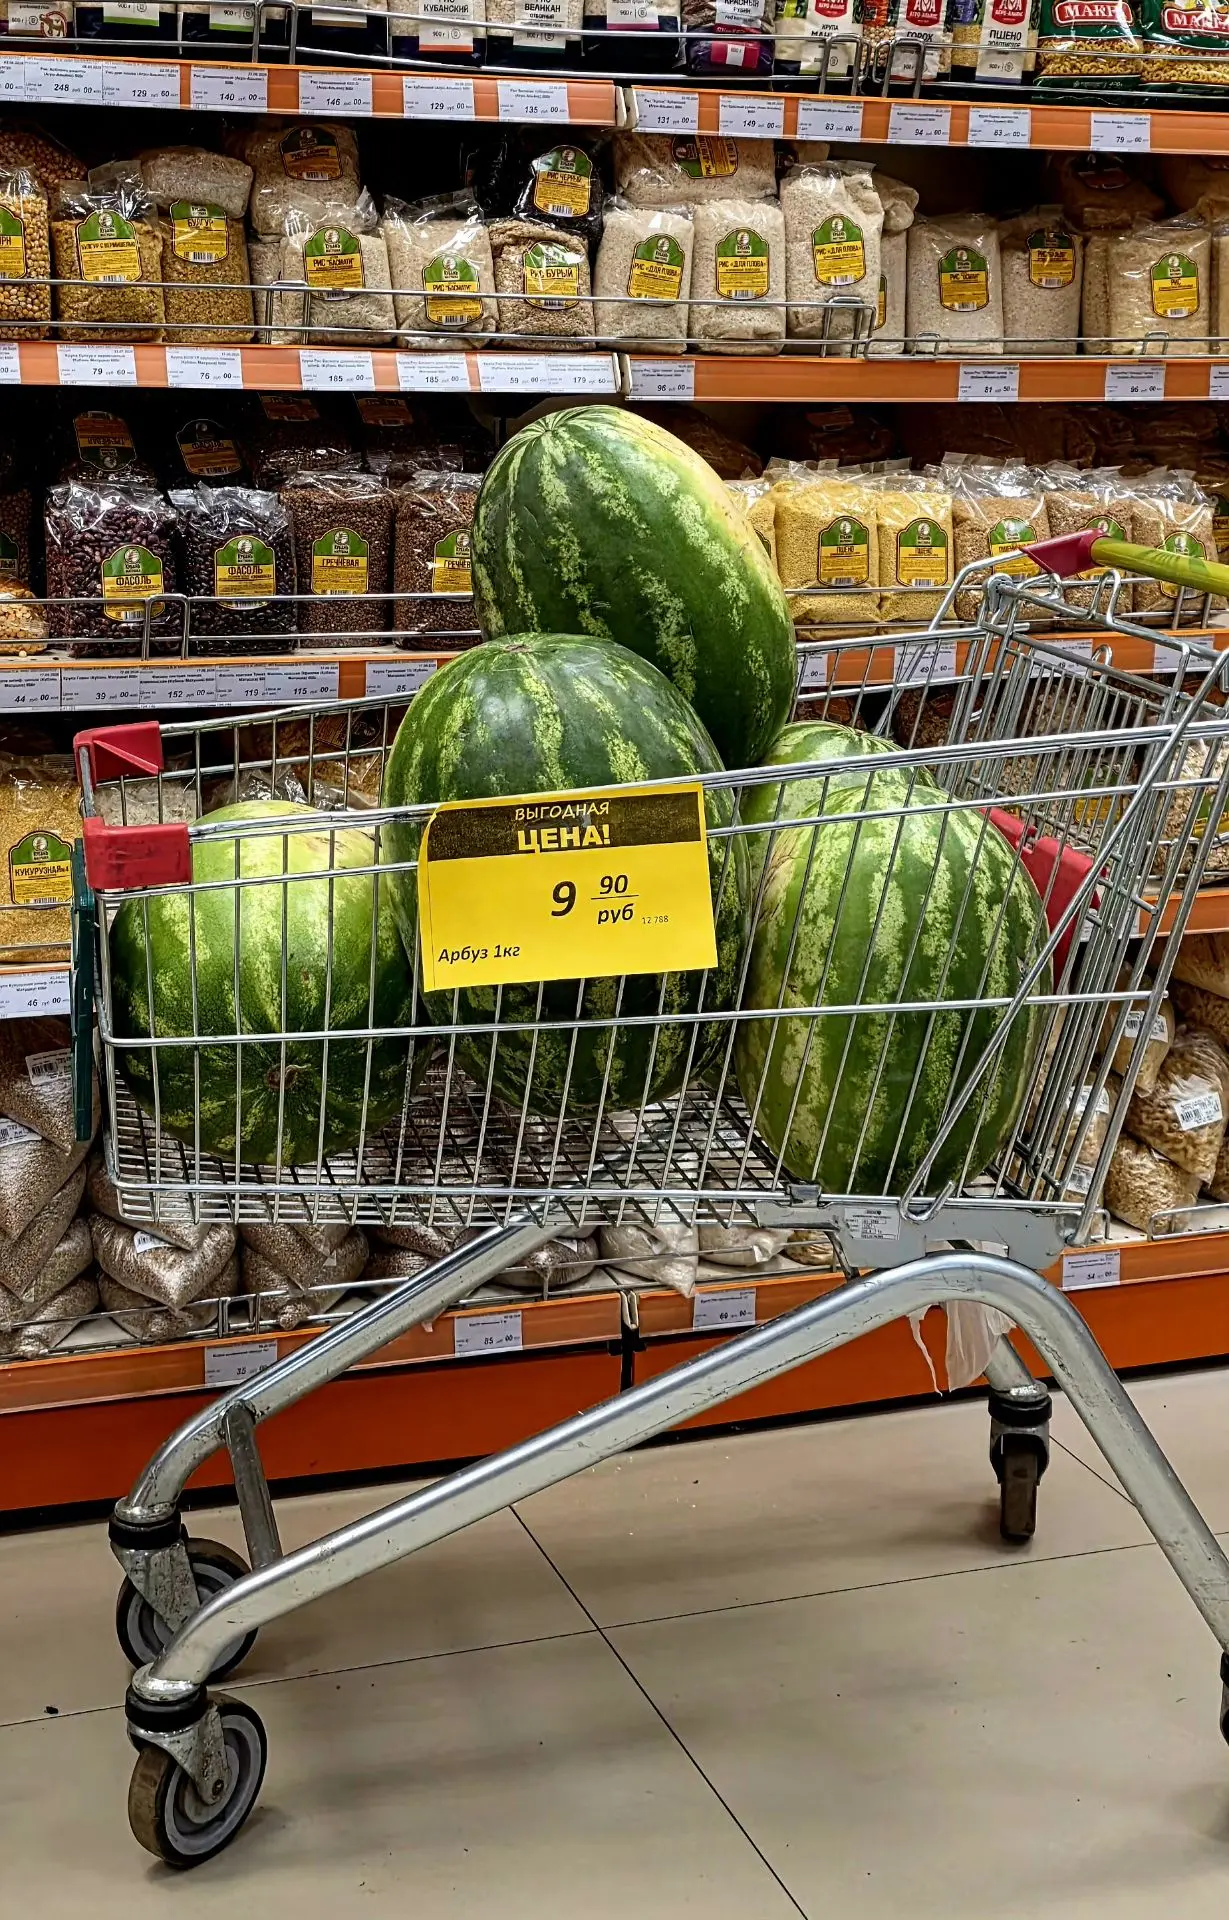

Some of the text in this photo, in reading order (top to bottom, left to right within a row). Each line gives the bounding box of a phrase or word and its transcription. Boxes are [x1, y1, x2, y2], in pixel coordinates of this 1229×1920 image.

[423, 4, 469, 13] КУБАНСКИЙ
[524, 4, 561, 13] ВЕЛИКАН
[821, 23, 839, 31] КРУПА
[906, 31, 934, 42] ГОРОХ
[989, 30, 1022, 41] ПШЕНО
[54, 82, 70, 92] 248
[83, 86, 93, 94] 00
[131, 89, 147, 98] 129
[219, 93, 235, 101] 140
[248, 93, 257, 101] 00
[326, 98, 341, 106] 146
[353, 98, 362, 106] 00
[429, 102, 445, 110] 129
[456, 102, 465, 110] 00
[524, 105, 539, 114] 135
[657, 116, 670, 124] 131
[743, 119, 775, 129] 149 00
[546, 171, 558, 181] РИС
[815, 248, 826, 256] РИС
[312, 258, 326, 267] РИС
[634, 263, 645, 271] РИС
[718, 260, 730, 268] РИС
[530, 267, 573, 279] РИС БУРЫЙ
[432, 284, 444, 292] РИС
[92, 368, 103, 376] 79
[328, 375, 343, 383] 185
[573, 376, 587, 384] 179
[657, 384, 667, 392] 96
[227, 566, 264, 576] ФАСОЛЬ
[116, 575, 152, 586] ФАСОЛЬ
[167, 690, 183, 699] 152
[245, 689, 259, 697] 119
[293, 687, 307, 695] 115
[14, 695, 26, 703] 44
[95, 692, 106, 700] 39
[515, 800, 610, 821] ВЫГОДНАЯ
[517, 824, 611, 853] ЦЕНА!
[15, 867, 61, 877] КУКУРУЗНАЯ
[600, 874, 629, 894] 90
[551, 880, 577, 917] 9
[597, 903, 634, 925] руб
[438, 944, 520, 964] Арбуз 1кг
[27, 999, 38, 1007] 46
